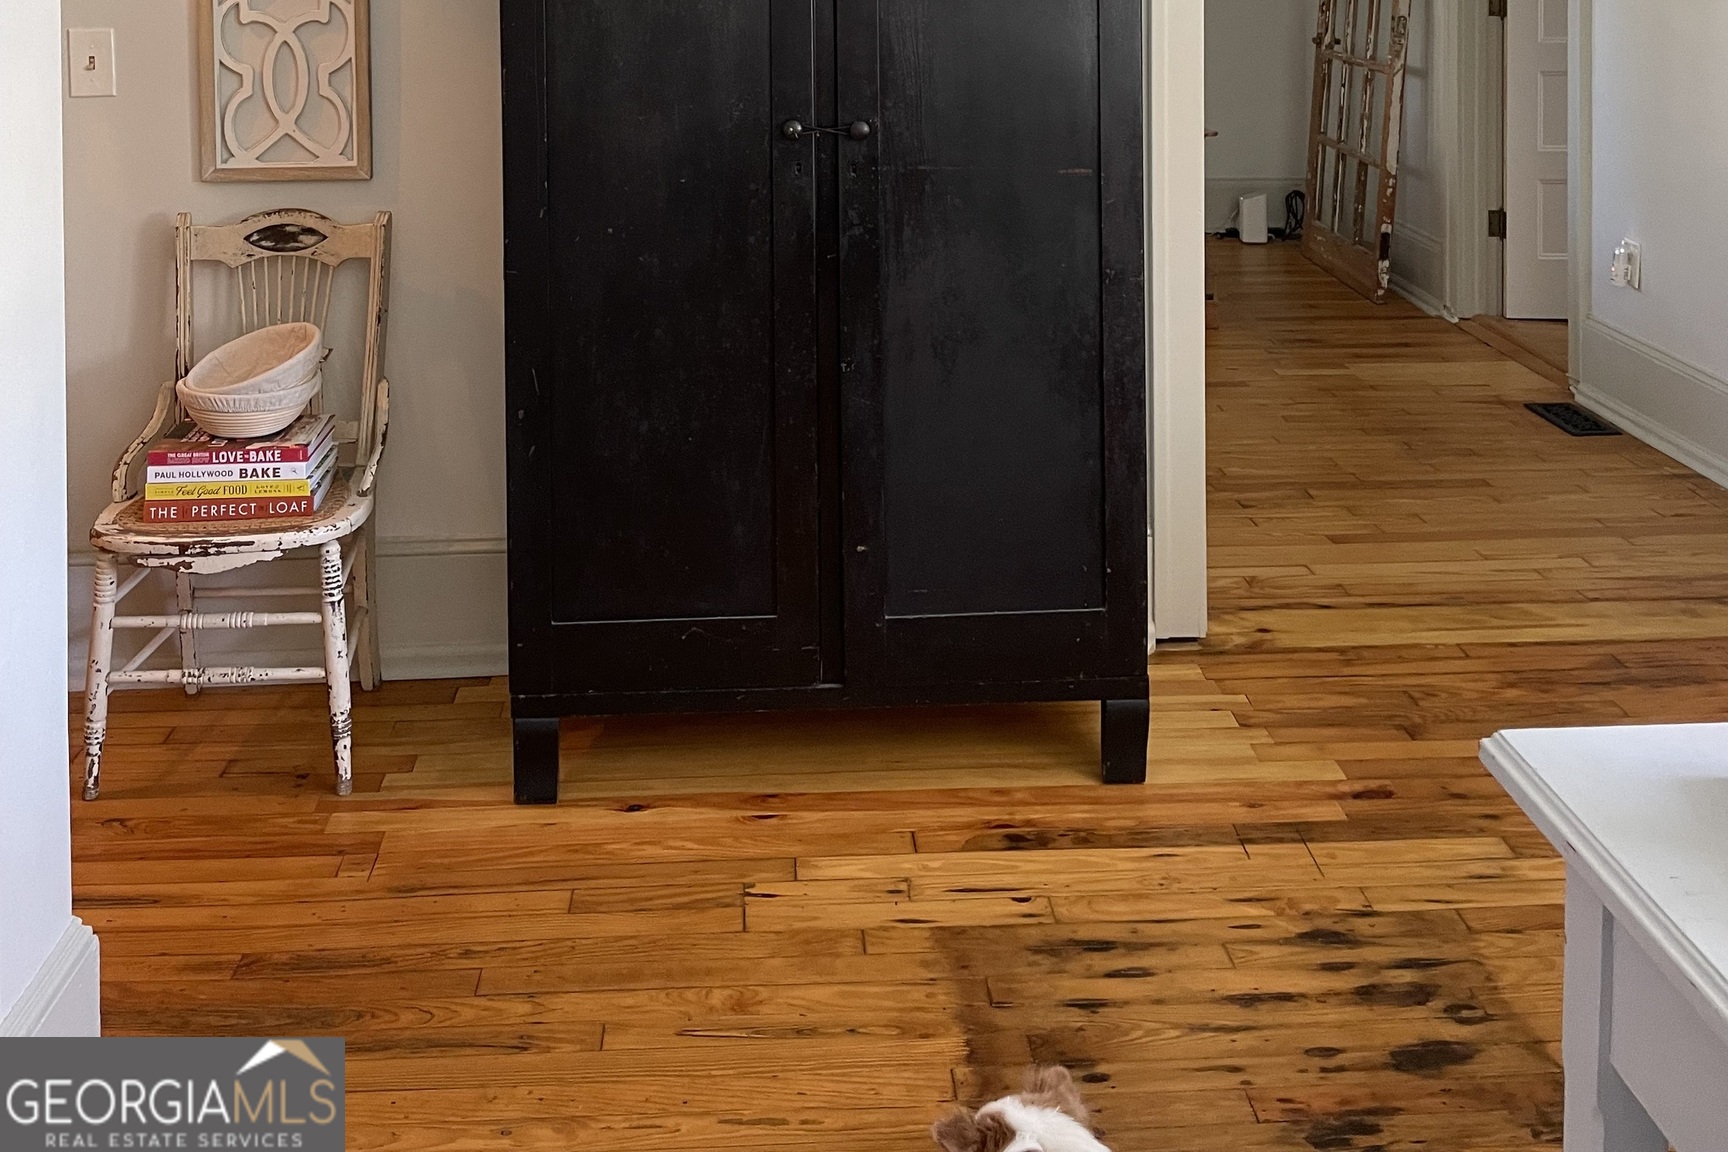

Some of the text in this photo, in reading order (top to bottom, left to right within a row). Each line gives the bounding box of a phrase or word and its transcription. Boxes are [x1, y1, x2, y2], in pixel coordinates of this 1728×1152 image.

[212, 451, 244, 463] LOVE
[249, 450, 282, 462] BAKE
[154, 469, 234, 479] PAUL HOLLYWOOD
[239, 467, 281, 479] BAKE
[176, 485, 248, 498] Feel Good FOOD
[150, 501, 308, 519] THE PERFECT LOAF
